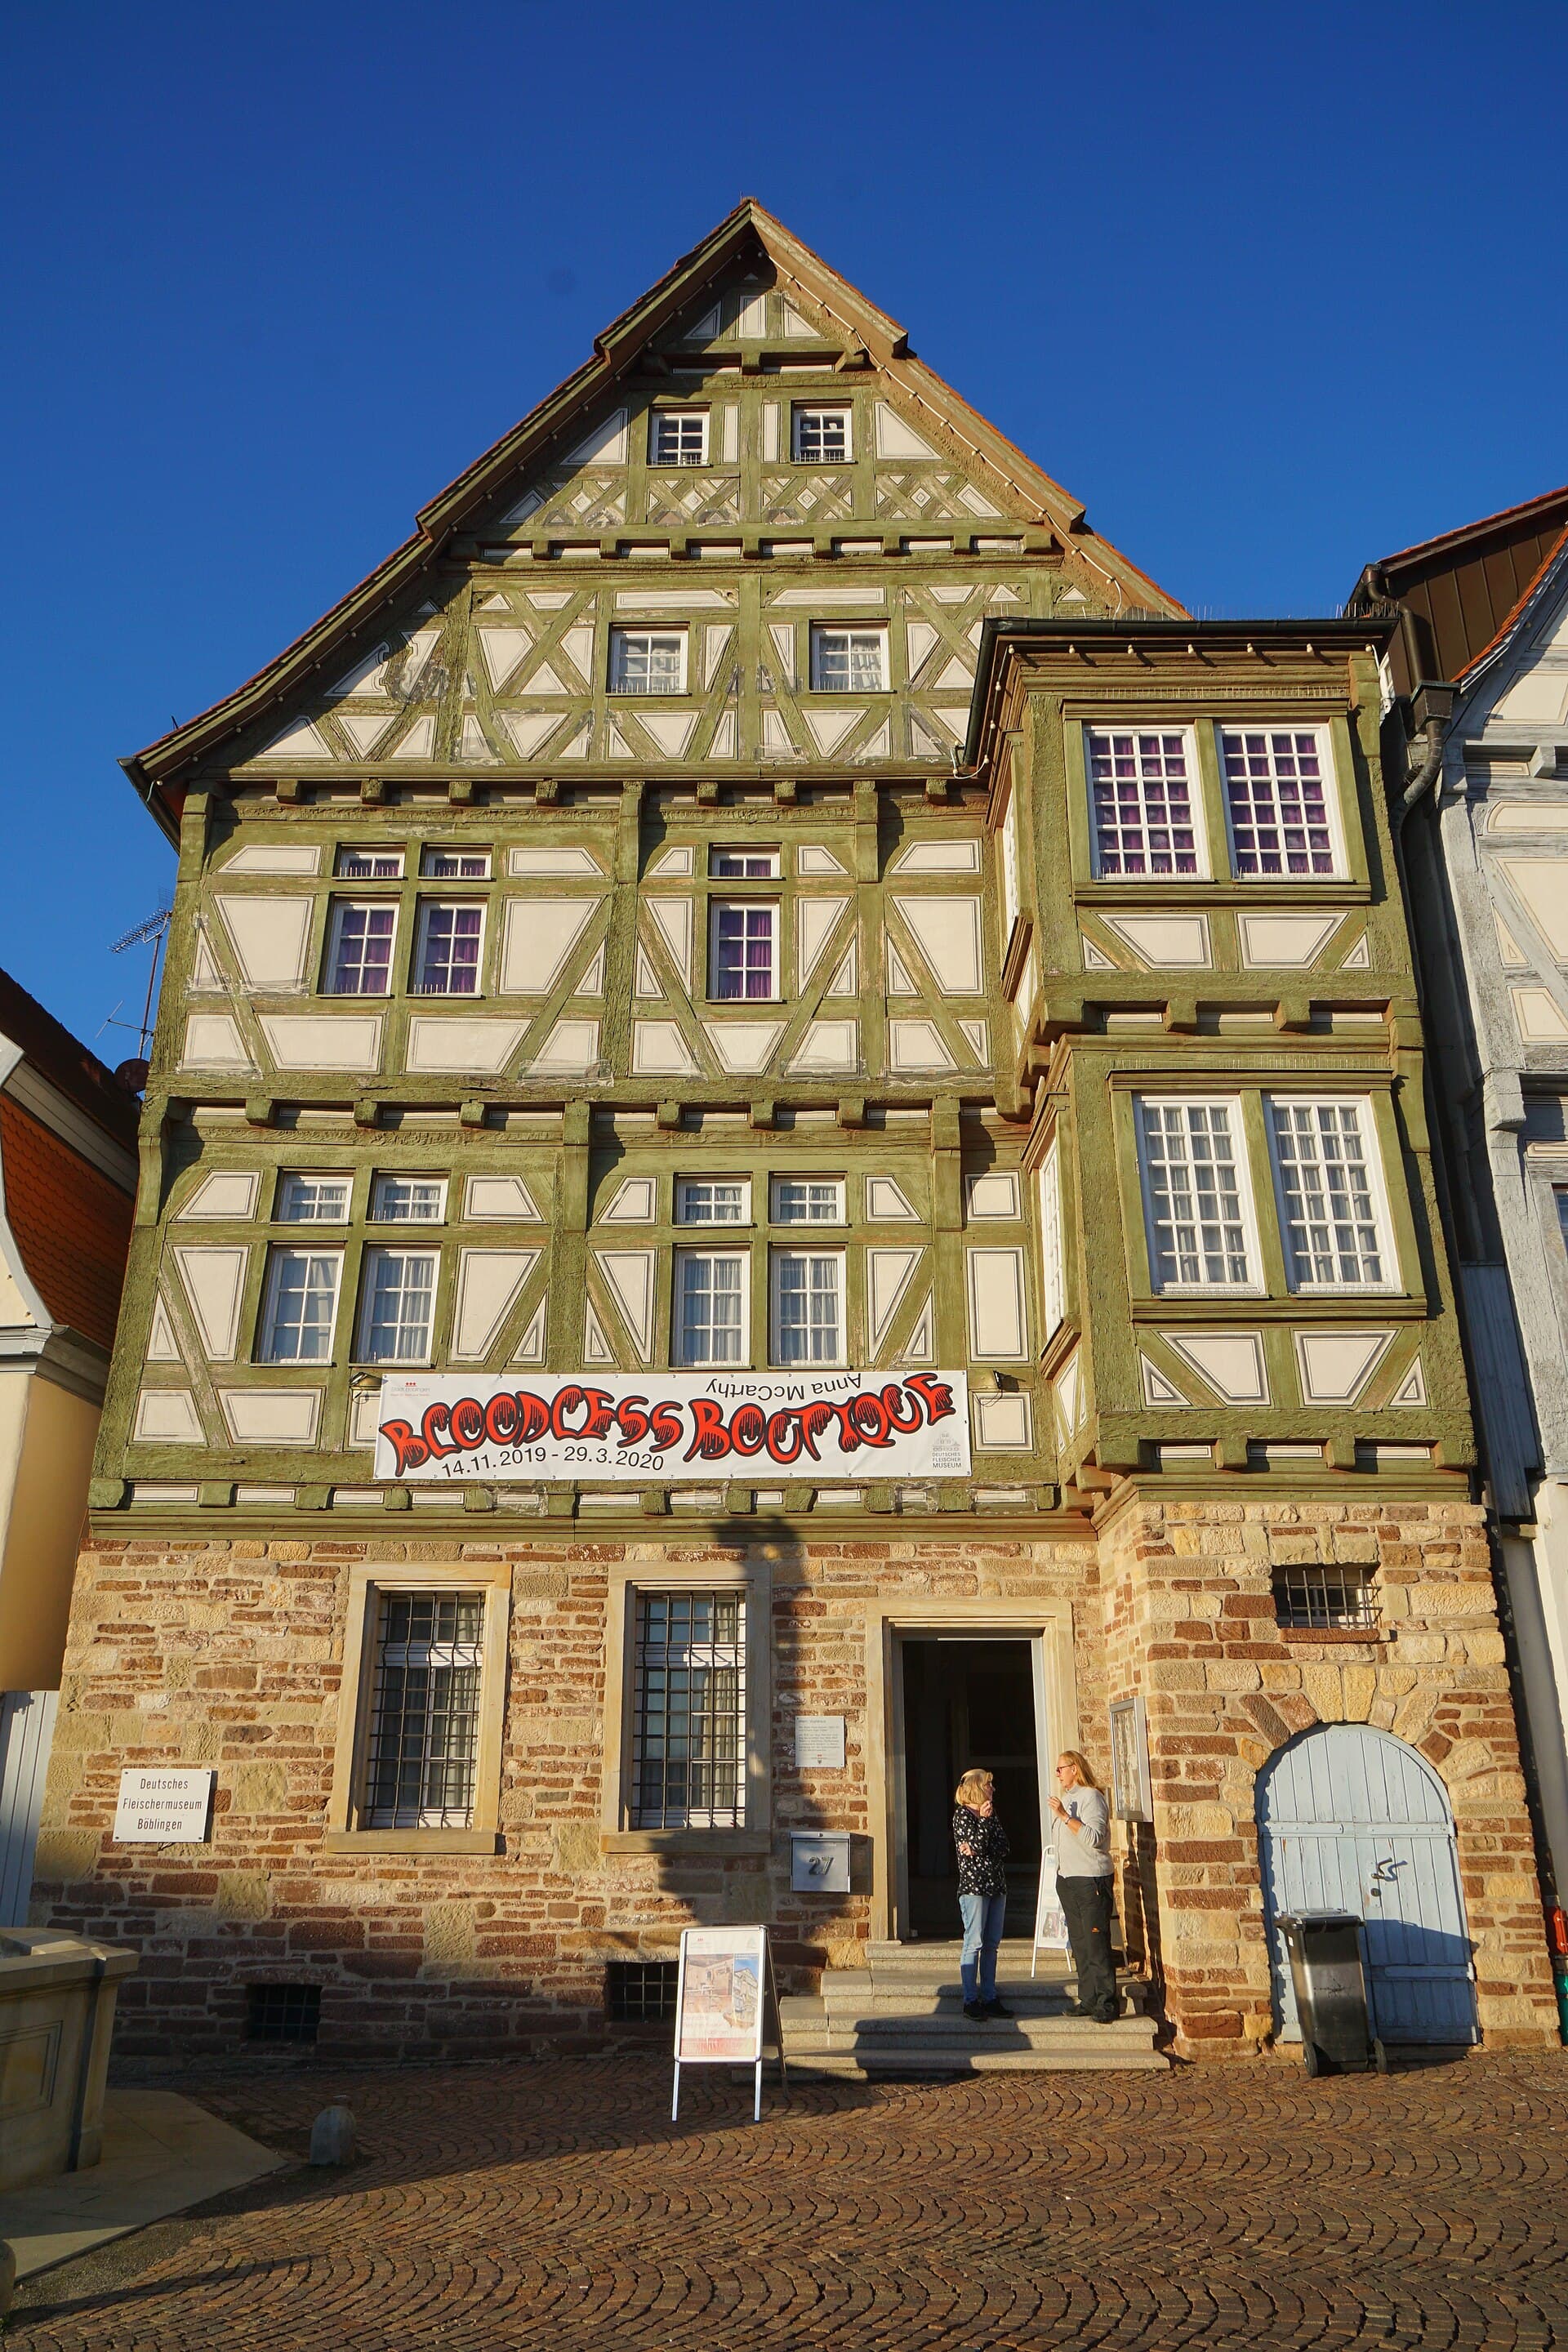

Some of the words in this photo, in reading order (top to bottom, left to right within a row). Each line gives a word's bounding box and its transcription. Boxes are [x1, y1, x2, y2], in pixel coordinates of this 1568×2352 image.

[706, 1378, 804, 1401] McCarthy
[811, 1373, 862, 1392] Anna
[442, 1446, 546, 1477] 14.11.2019
[564, 1446, 665, 1471] 29.3.2020
[140, 1778, 189, 1790] Deutsches
[122, 1797, 203, 1811] Fleischermuseum
[137, 1817, 182, 1832] Böblingen
[808, 1856, 834, 1876] 27
